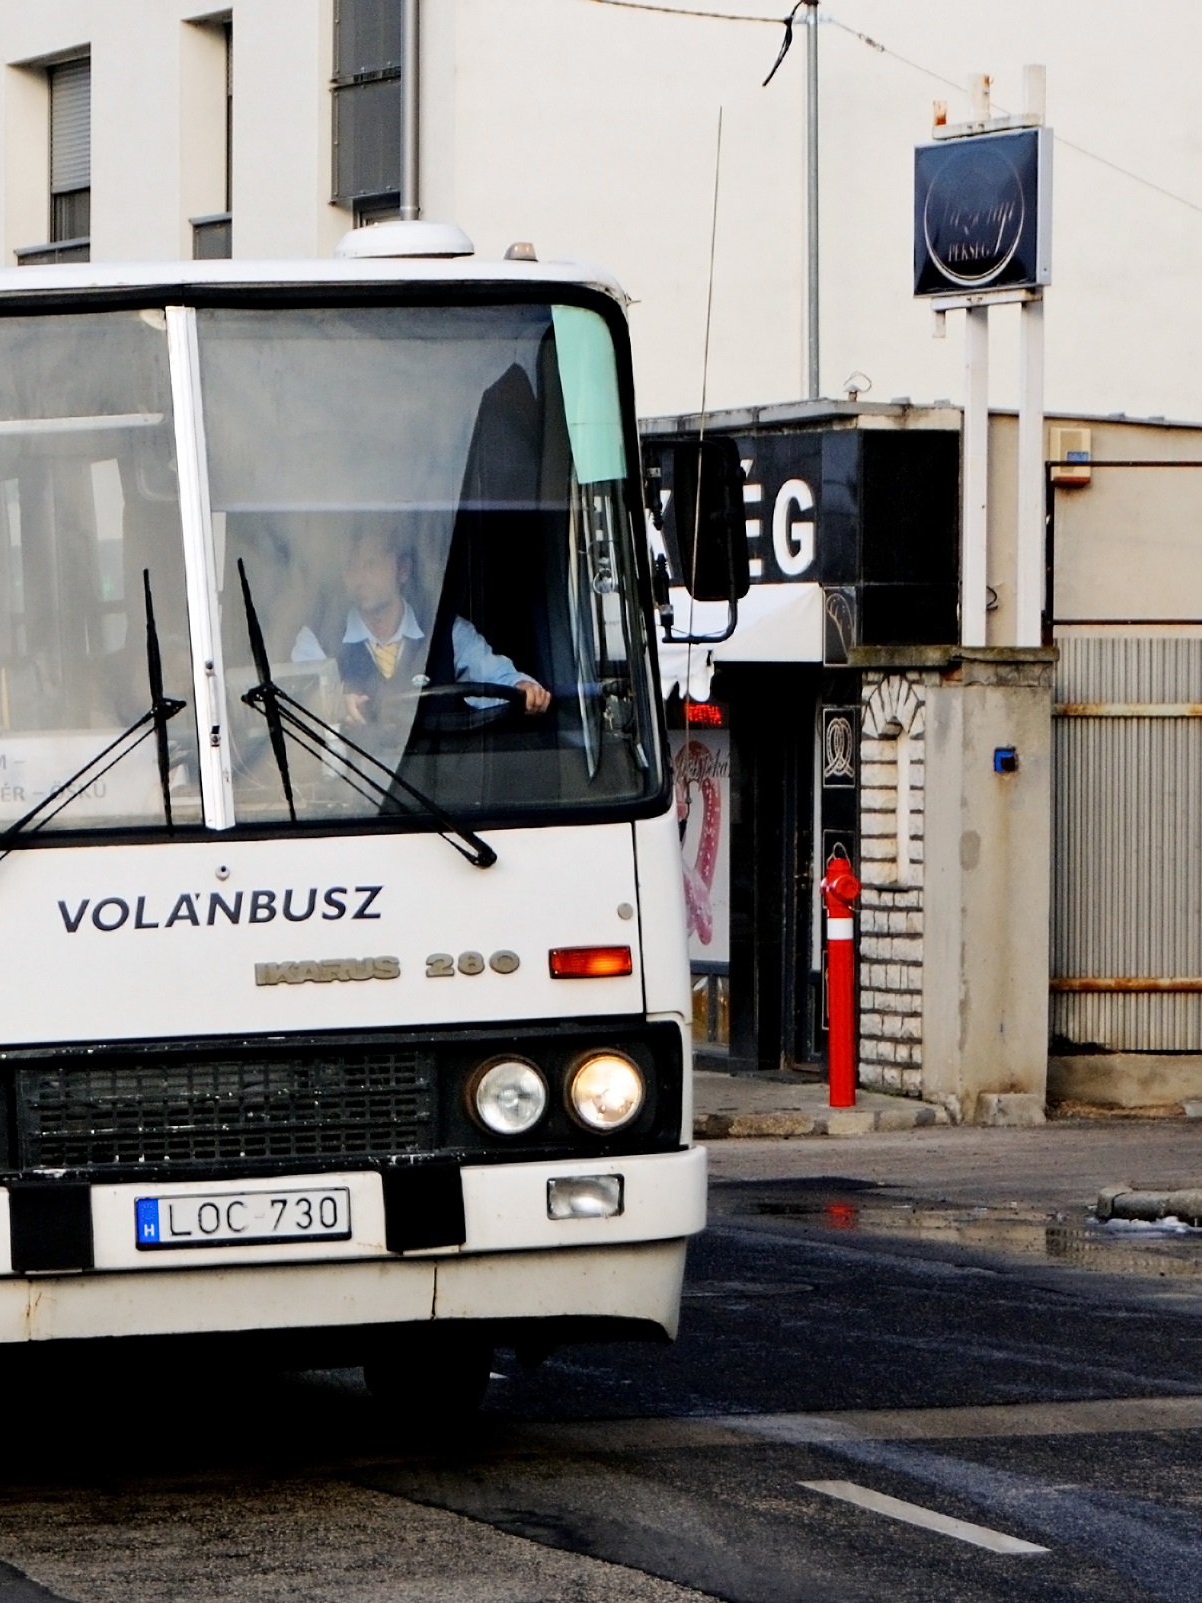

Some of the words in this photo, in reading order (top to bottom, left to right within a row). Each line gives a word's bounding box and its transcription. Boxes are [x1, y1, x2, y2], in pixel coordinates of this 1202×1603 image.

[57, 886, 384, 933] VOLÁNBUSZ
[254, 955, 401, 986] IKARUS
[425, 949, 521, 977] 280
[143, 1224, 155, 1237] H
